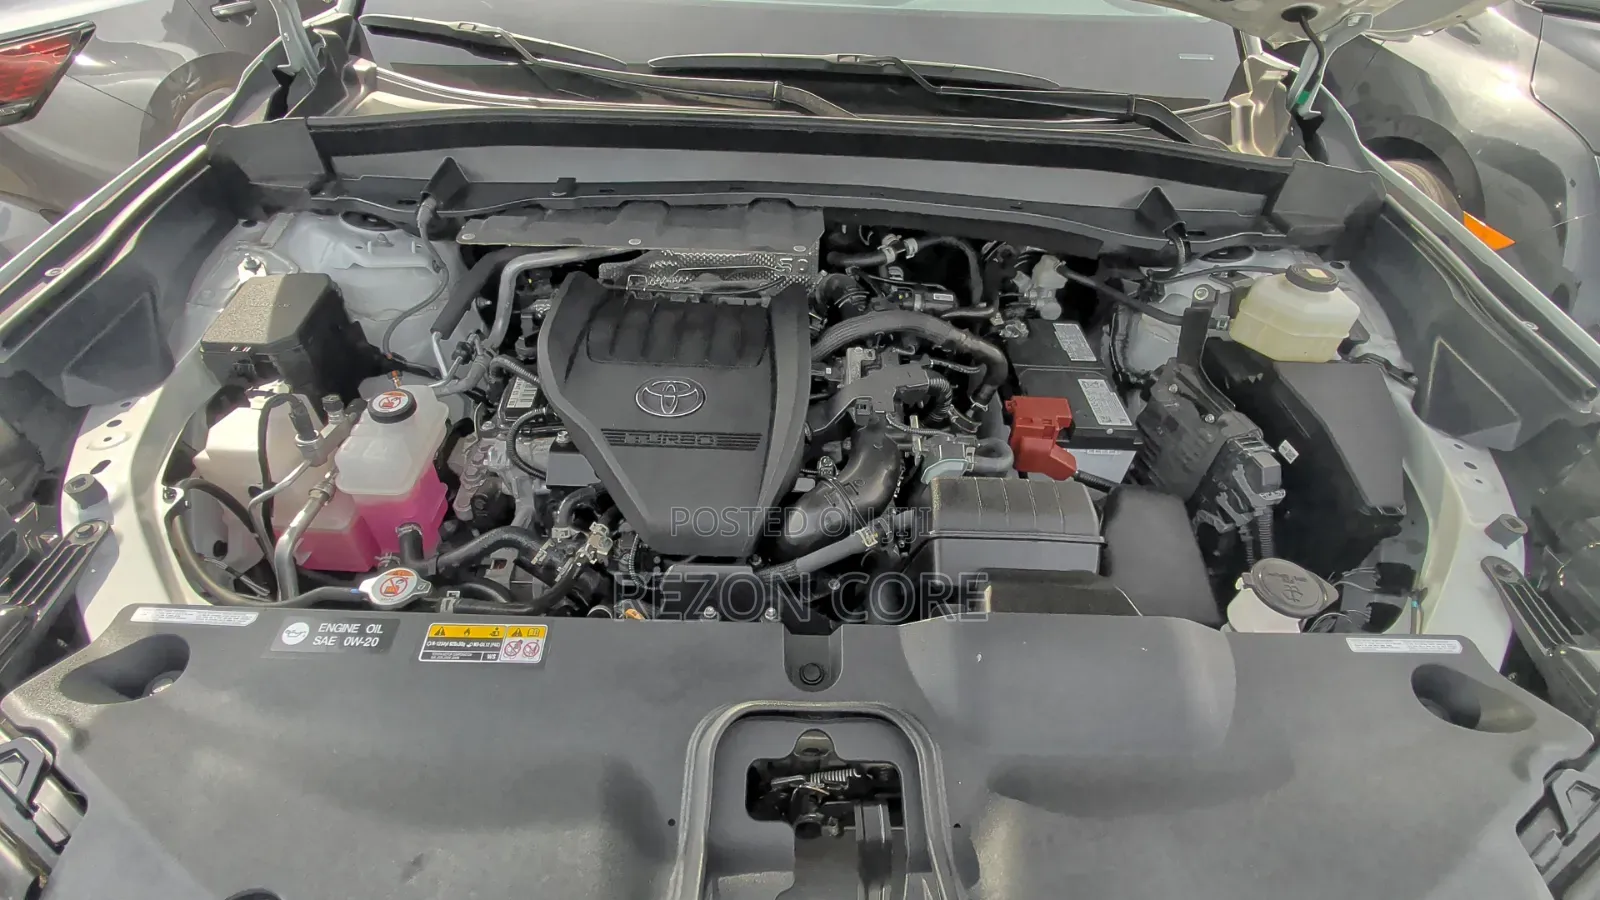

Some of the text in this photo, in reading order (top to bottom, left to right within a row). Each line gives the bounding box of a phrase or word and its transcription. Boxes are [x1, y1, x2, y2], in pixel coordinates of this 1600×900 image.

[624, 431, 717, 448] TURBO
[318, 623, 384, 633] ENGINE OIL
[312, 636, 380, 647] SAE 0W-20
